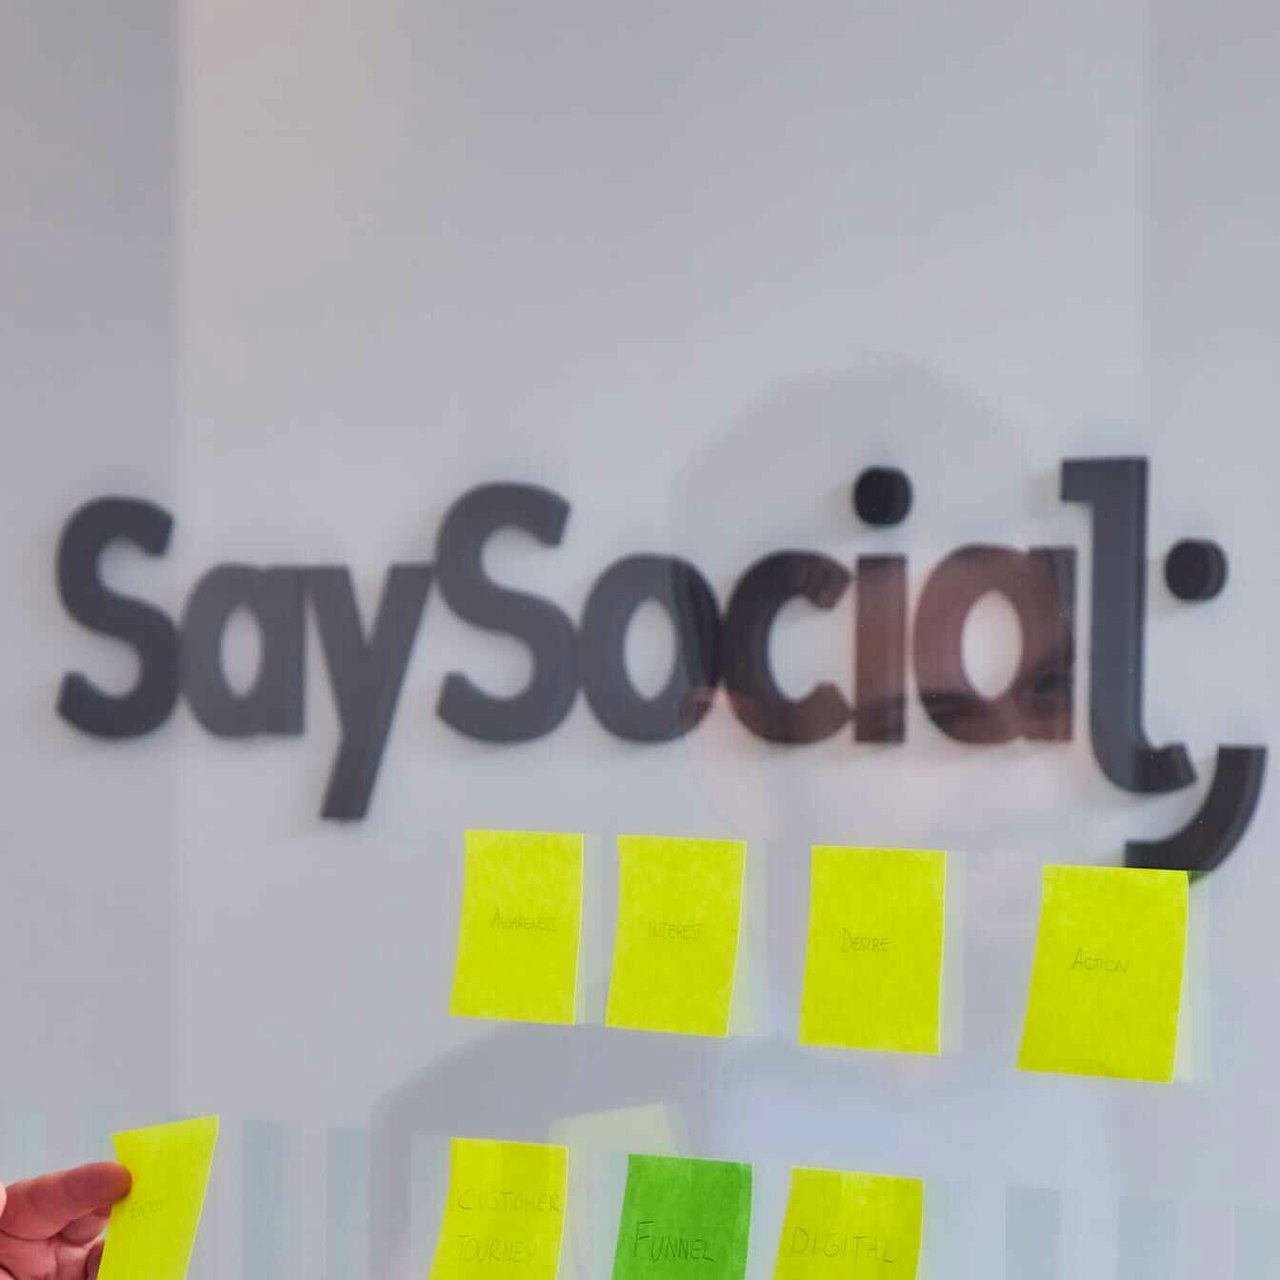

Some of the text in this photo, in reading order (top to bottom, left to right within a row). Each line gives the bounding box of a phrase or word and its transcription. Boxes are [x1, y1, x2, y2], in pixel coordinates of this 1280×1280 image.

[457, 1188, 560, 1213] CUSTOMER
[633, 1221, 715, 1264] FUNNEL
[790, 1227, 895, 1265] DIGITAL
